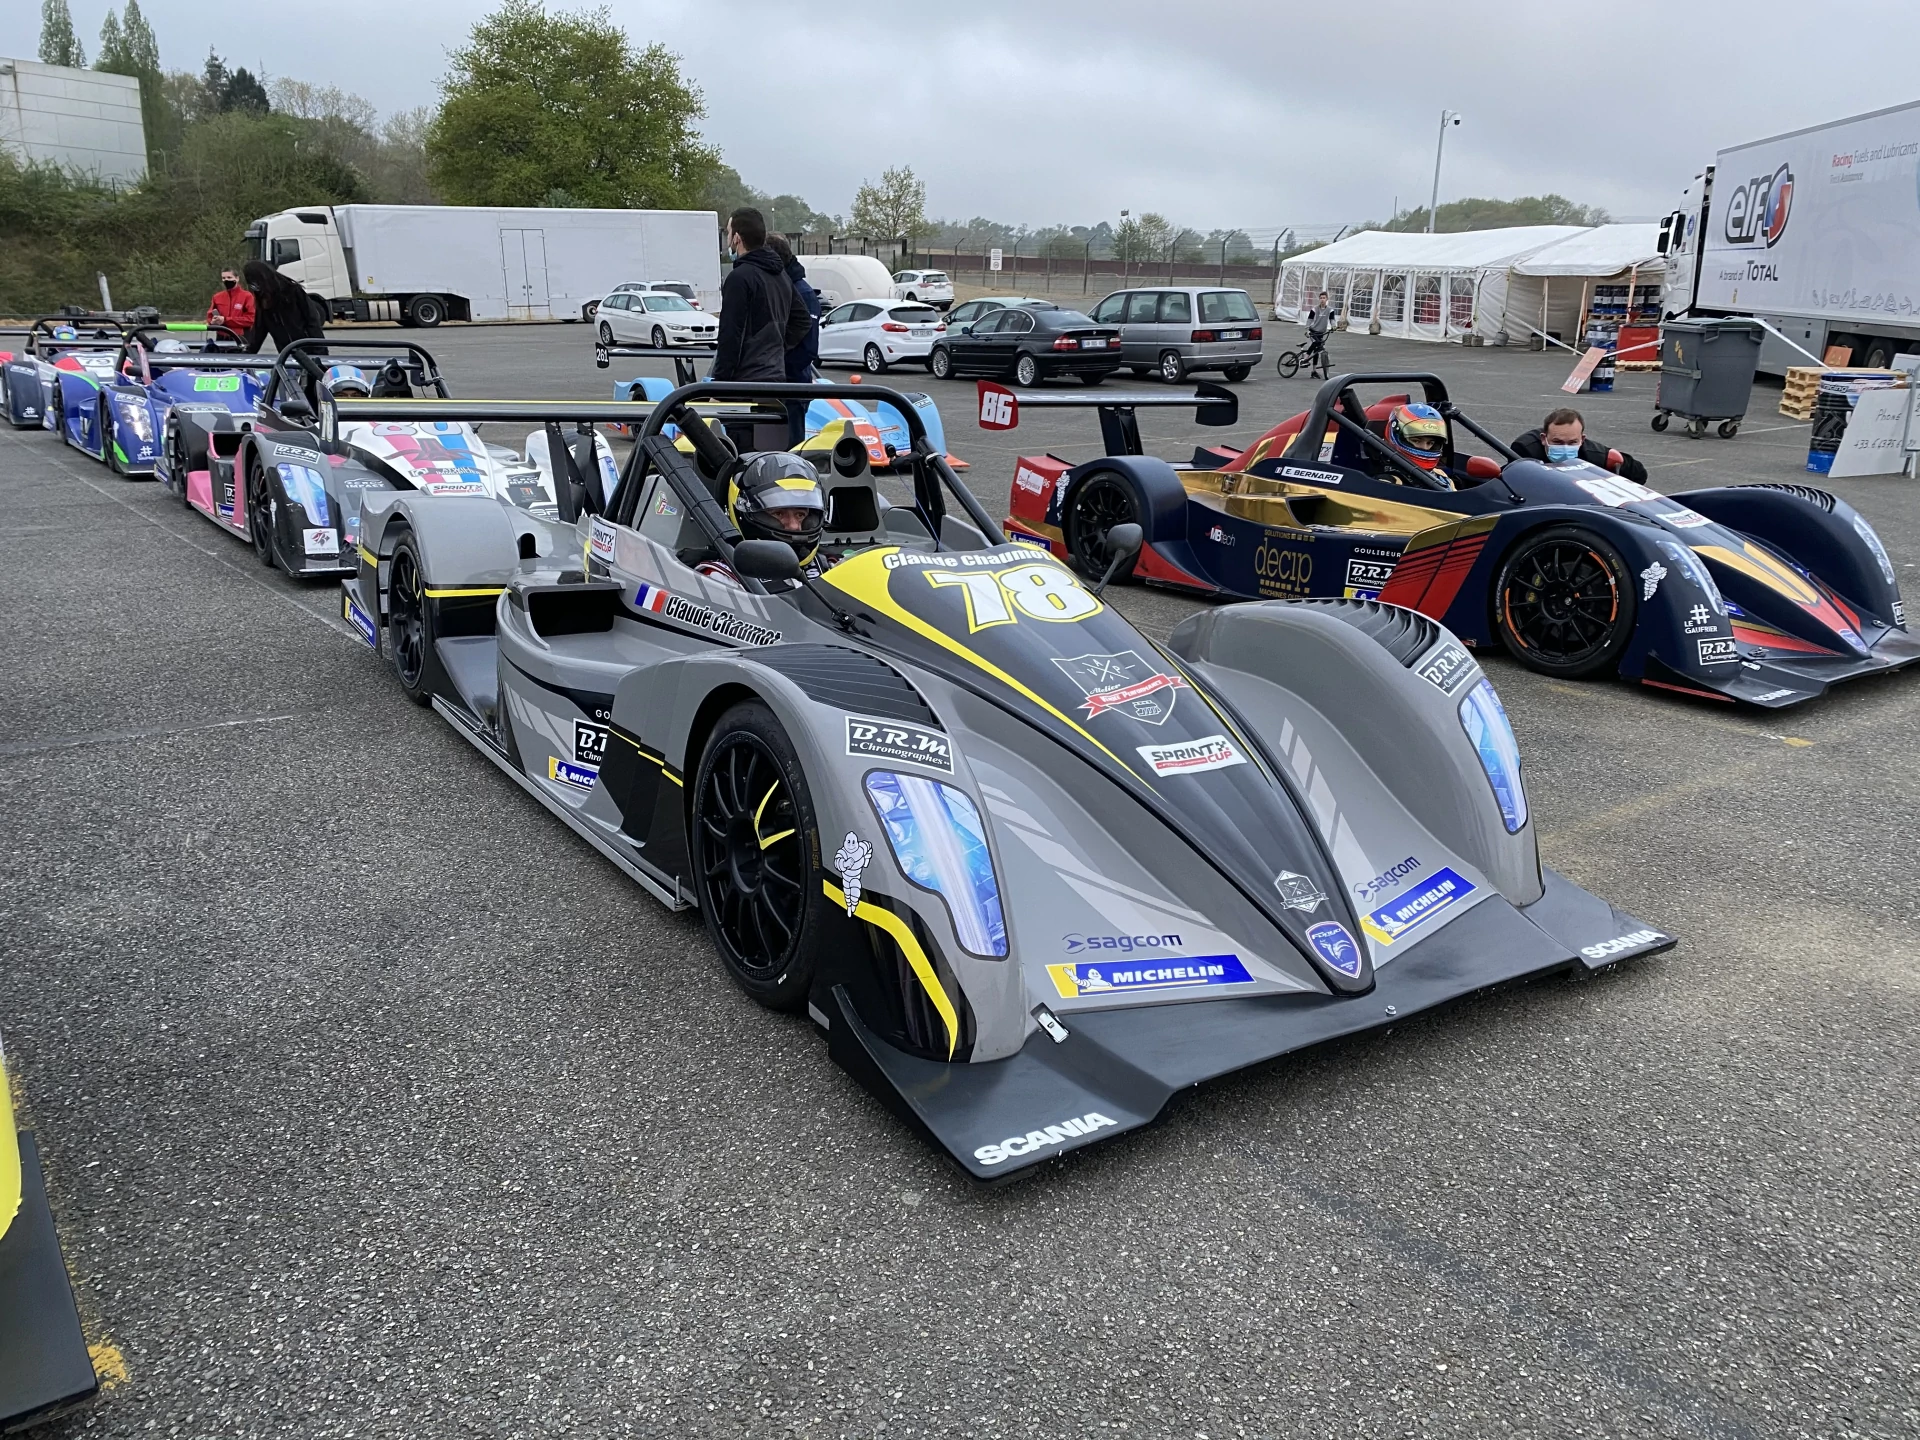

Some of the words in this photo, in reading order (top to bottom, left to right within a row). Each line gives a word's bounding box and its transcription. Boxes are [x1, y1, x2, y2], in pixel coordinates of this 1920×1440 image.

[1832, 152, 1853, 168] Racing
[1854, 148, 1870, 164] Fuels
[1870, 144, 1882, 161] and
[1883, 142, 1918, 159] Lubricants
[1747, 260, 1779, 282] TOTAL
[596, 348, 609, 362] 261
[981, 391, 1014, 426] 86
[1294, 470, 1340, 482] BERNARD
[1264, 529, 1291, 540] SOLUTIONS
[884, 550, 960, 570] Claude
[1354, 548, 1402, 558] GOULIBEUR
[923, 563, 1104, 634] 78
[1258, 588, 1287, 598] MACHINES
[665, 595, 714, 628] Claude
[1684, 626, 1718, 634] GAUFRIER
[1424, 648, 1466, 685] B.R.M
[1090, 684, 1121, 694] Atelier
[850, 722, 950, 758] B.R.M
[860, 742, 944, 766] Chronographes
[1152, 742, 1214, 762] SPRINT
[1208, 750, 1232, 763] CUP
[1368, 856, 1422, 893] sagcom
[1396, 880, 1456, 922] MICHELIN
[1087, 934, 1183, 952] sagcom
[1581, 930, 1666, 958] SCANIA
[1113, 965, 1224, 984] MICHELIN
[974, 1112, 1118, 1166] SCANIA
